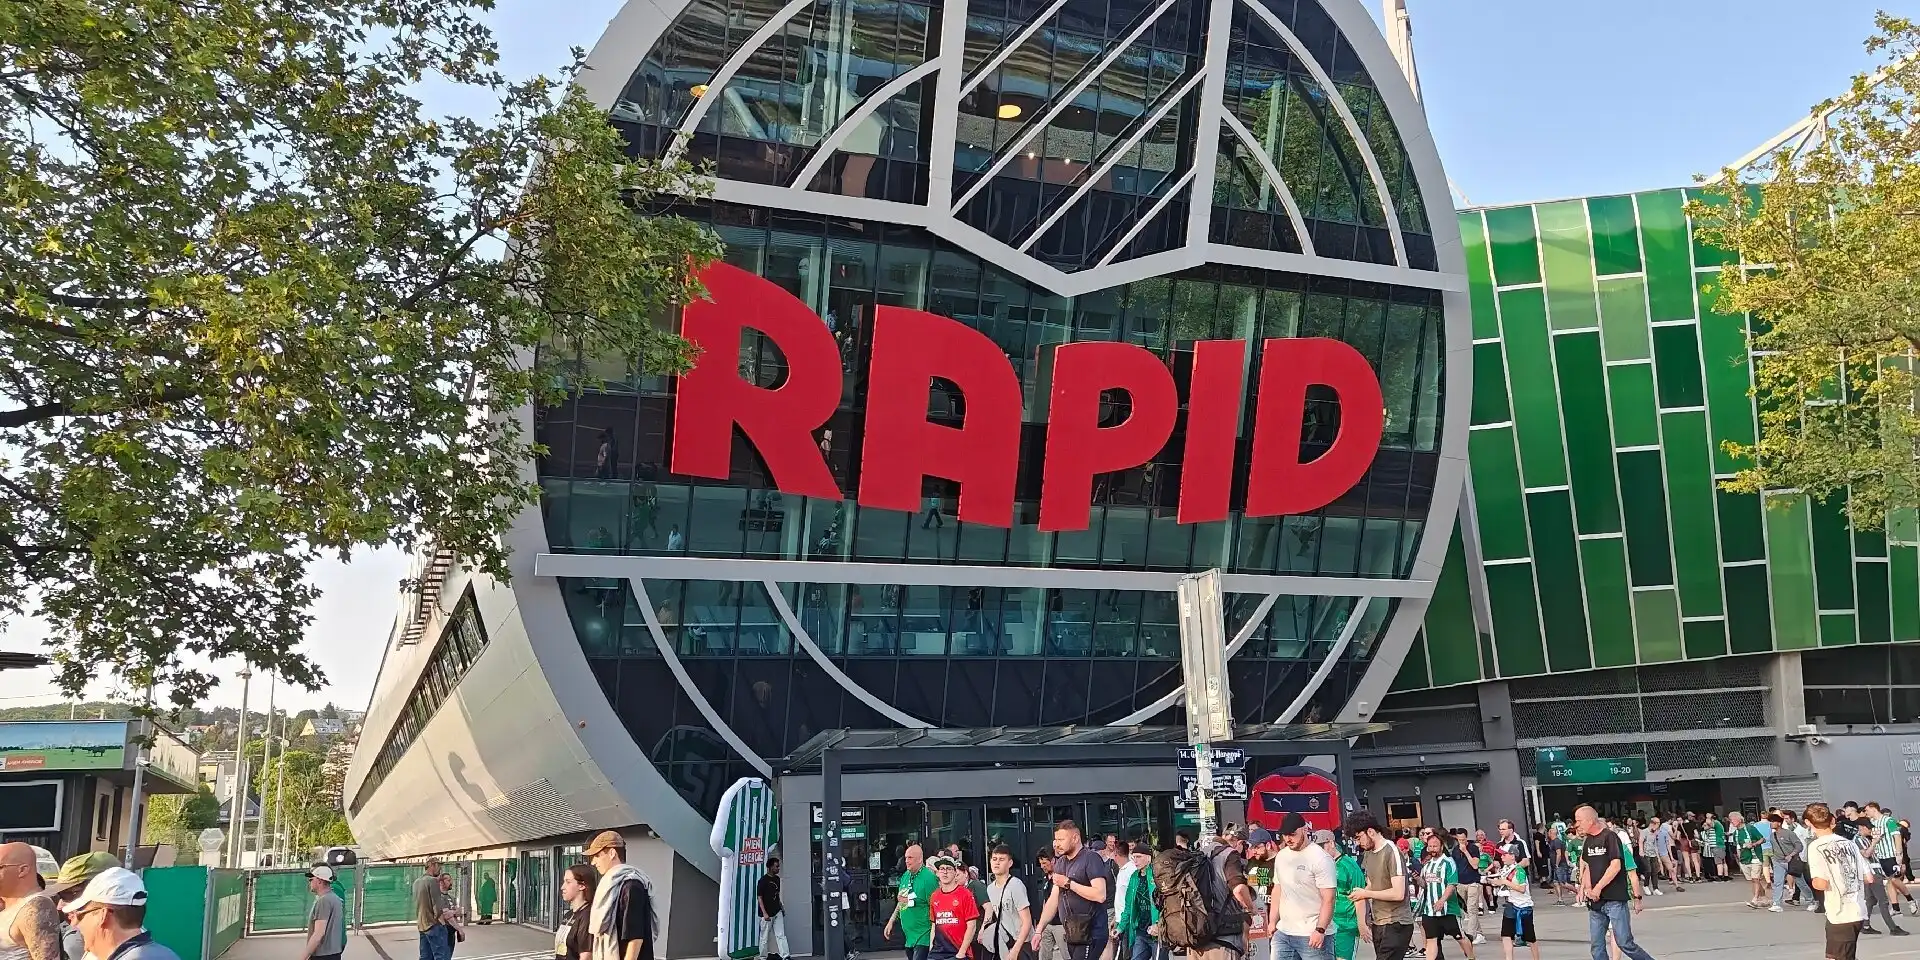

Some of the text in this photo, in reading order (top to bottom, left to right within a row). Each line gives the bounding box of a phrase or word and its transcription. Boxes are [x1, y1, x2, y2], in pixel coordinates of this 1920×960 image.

[671, 256, 1385, 532] RAPID
[1552, 769, 1573, 777] 19-20
[1609, 766, 1631, 774] 19-20
[1414, 786, 1420, 796] 3
[1467, 783, 1474, 792] 4
[1363, 789, 1368, 798] 2
[745, 839, 761, 850] WIEN
[740, 851, 764, 864] ENERGIE
